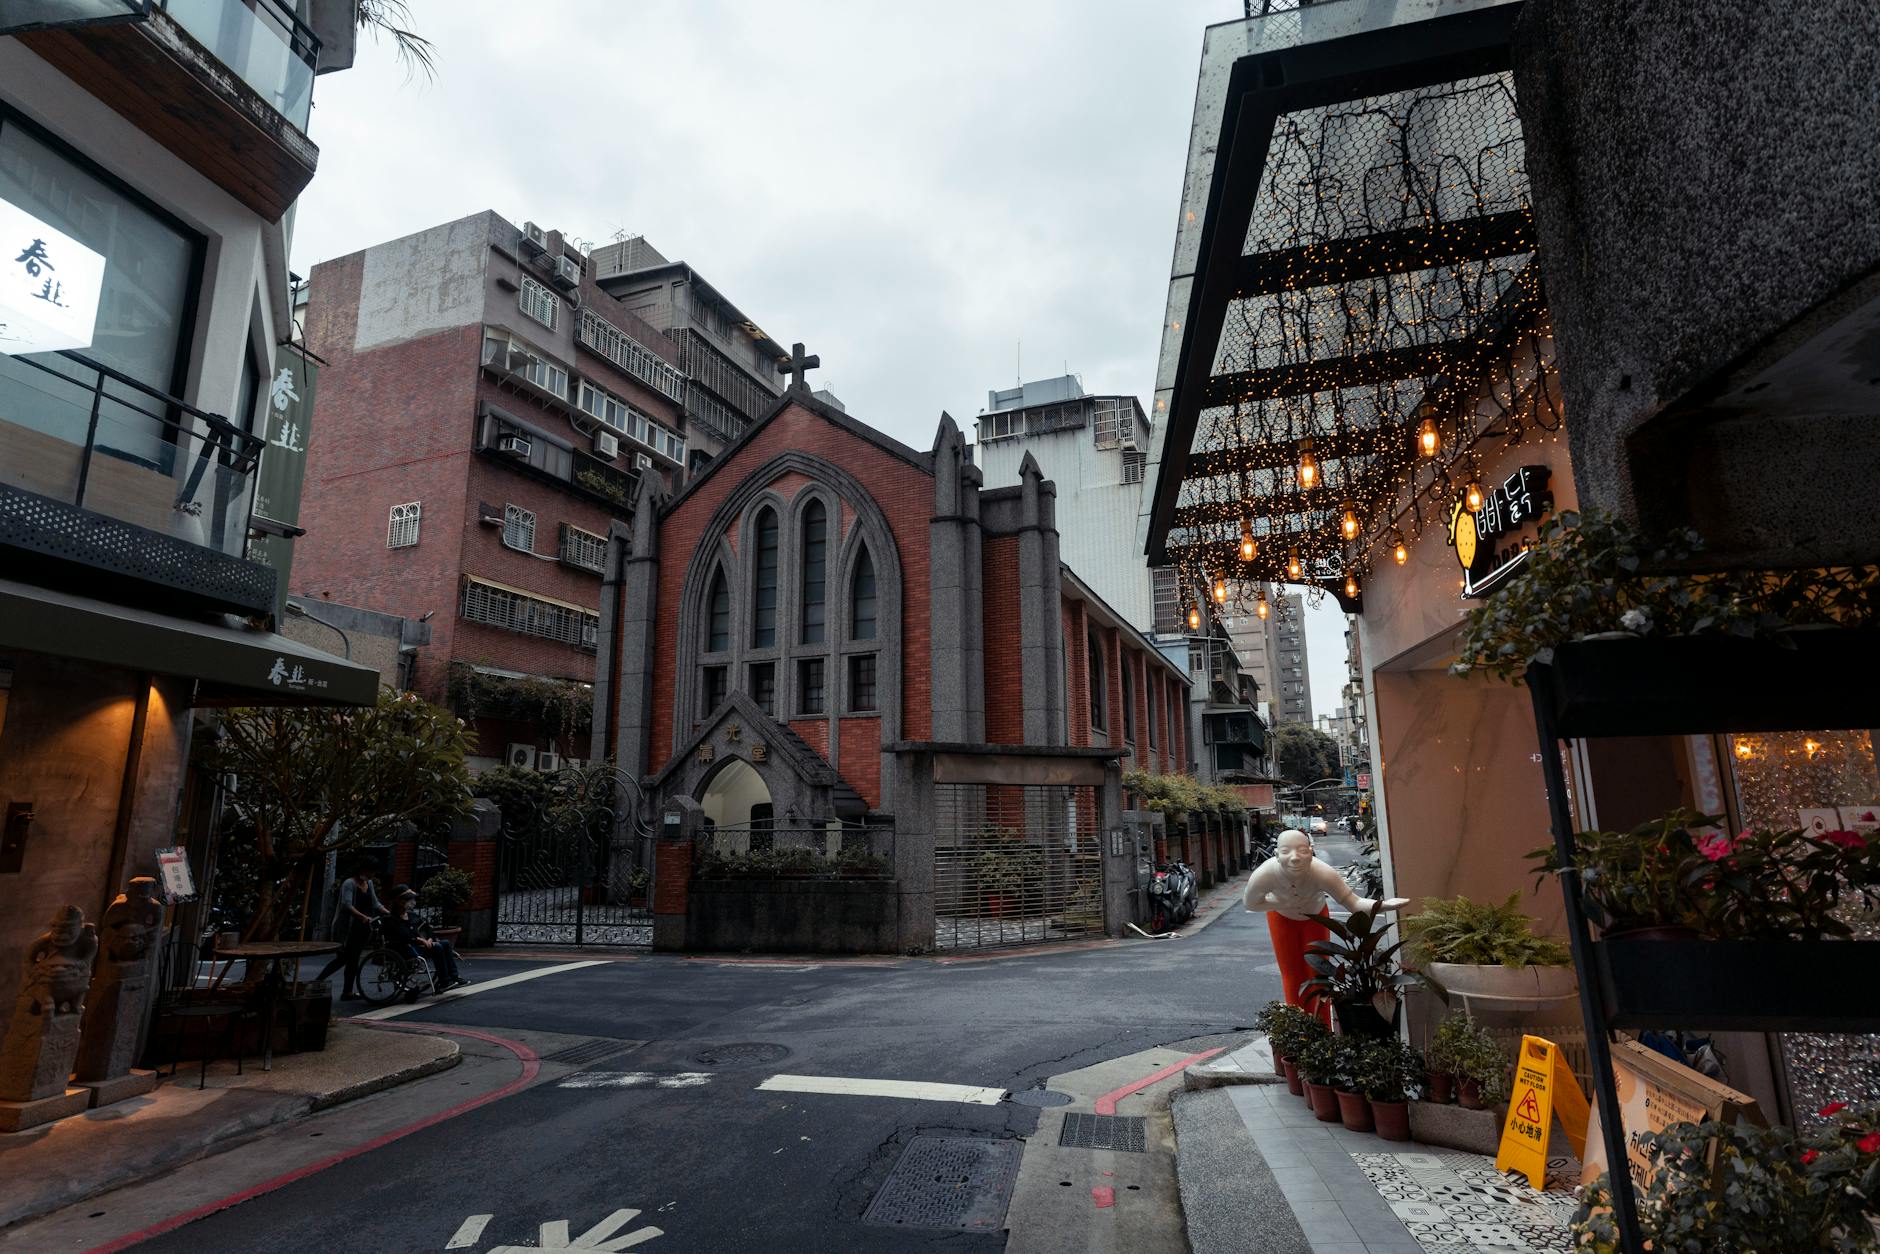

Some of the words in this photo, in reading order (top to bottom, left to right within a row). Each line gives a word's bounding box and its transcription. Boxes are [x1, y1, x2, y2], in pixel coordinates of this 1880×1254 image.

[1523, 1071, 1544, 1083] CAUTION
[1529, 1080, 1546, 1092] FLOOR
[1511, 1117, 1542, 1142] 小心地滑
